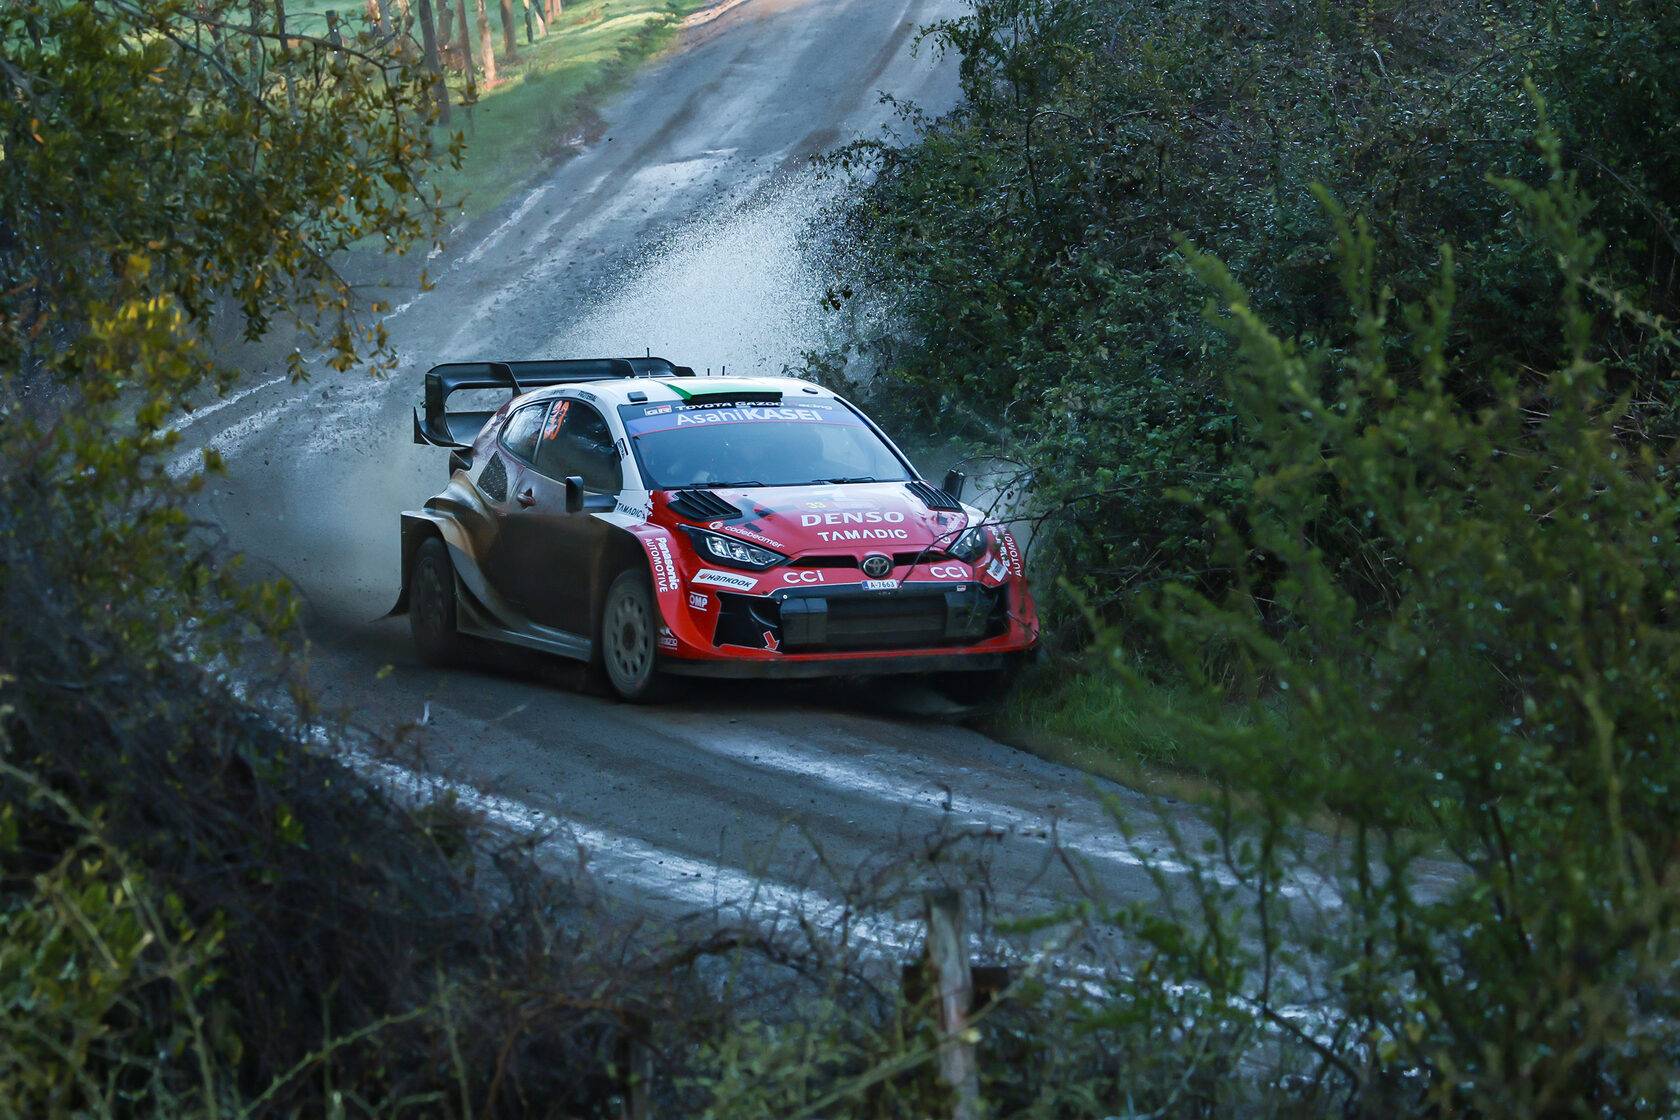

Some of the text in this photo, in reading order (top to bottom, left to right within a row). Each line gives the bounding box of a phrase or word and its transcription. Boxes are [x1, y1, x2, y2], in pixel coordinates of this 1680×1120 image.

[675, 402, 733, 411] TOYOTA
[616, 502, 643, 518] TAMADIC
[805, 501, 827, 509] 33
[800, 511, 905, 527] DENSO
[724, 524, 784, 549] codebeamer
[817, 528, 909, 542] TAMADIC
[644, 538, 669, 593] AUTOMOTIVE
[655, 537, 681, 590] Panasonic
[870, 580, 895, 589] A-7663
[689, 594, 708, 608] OMP
